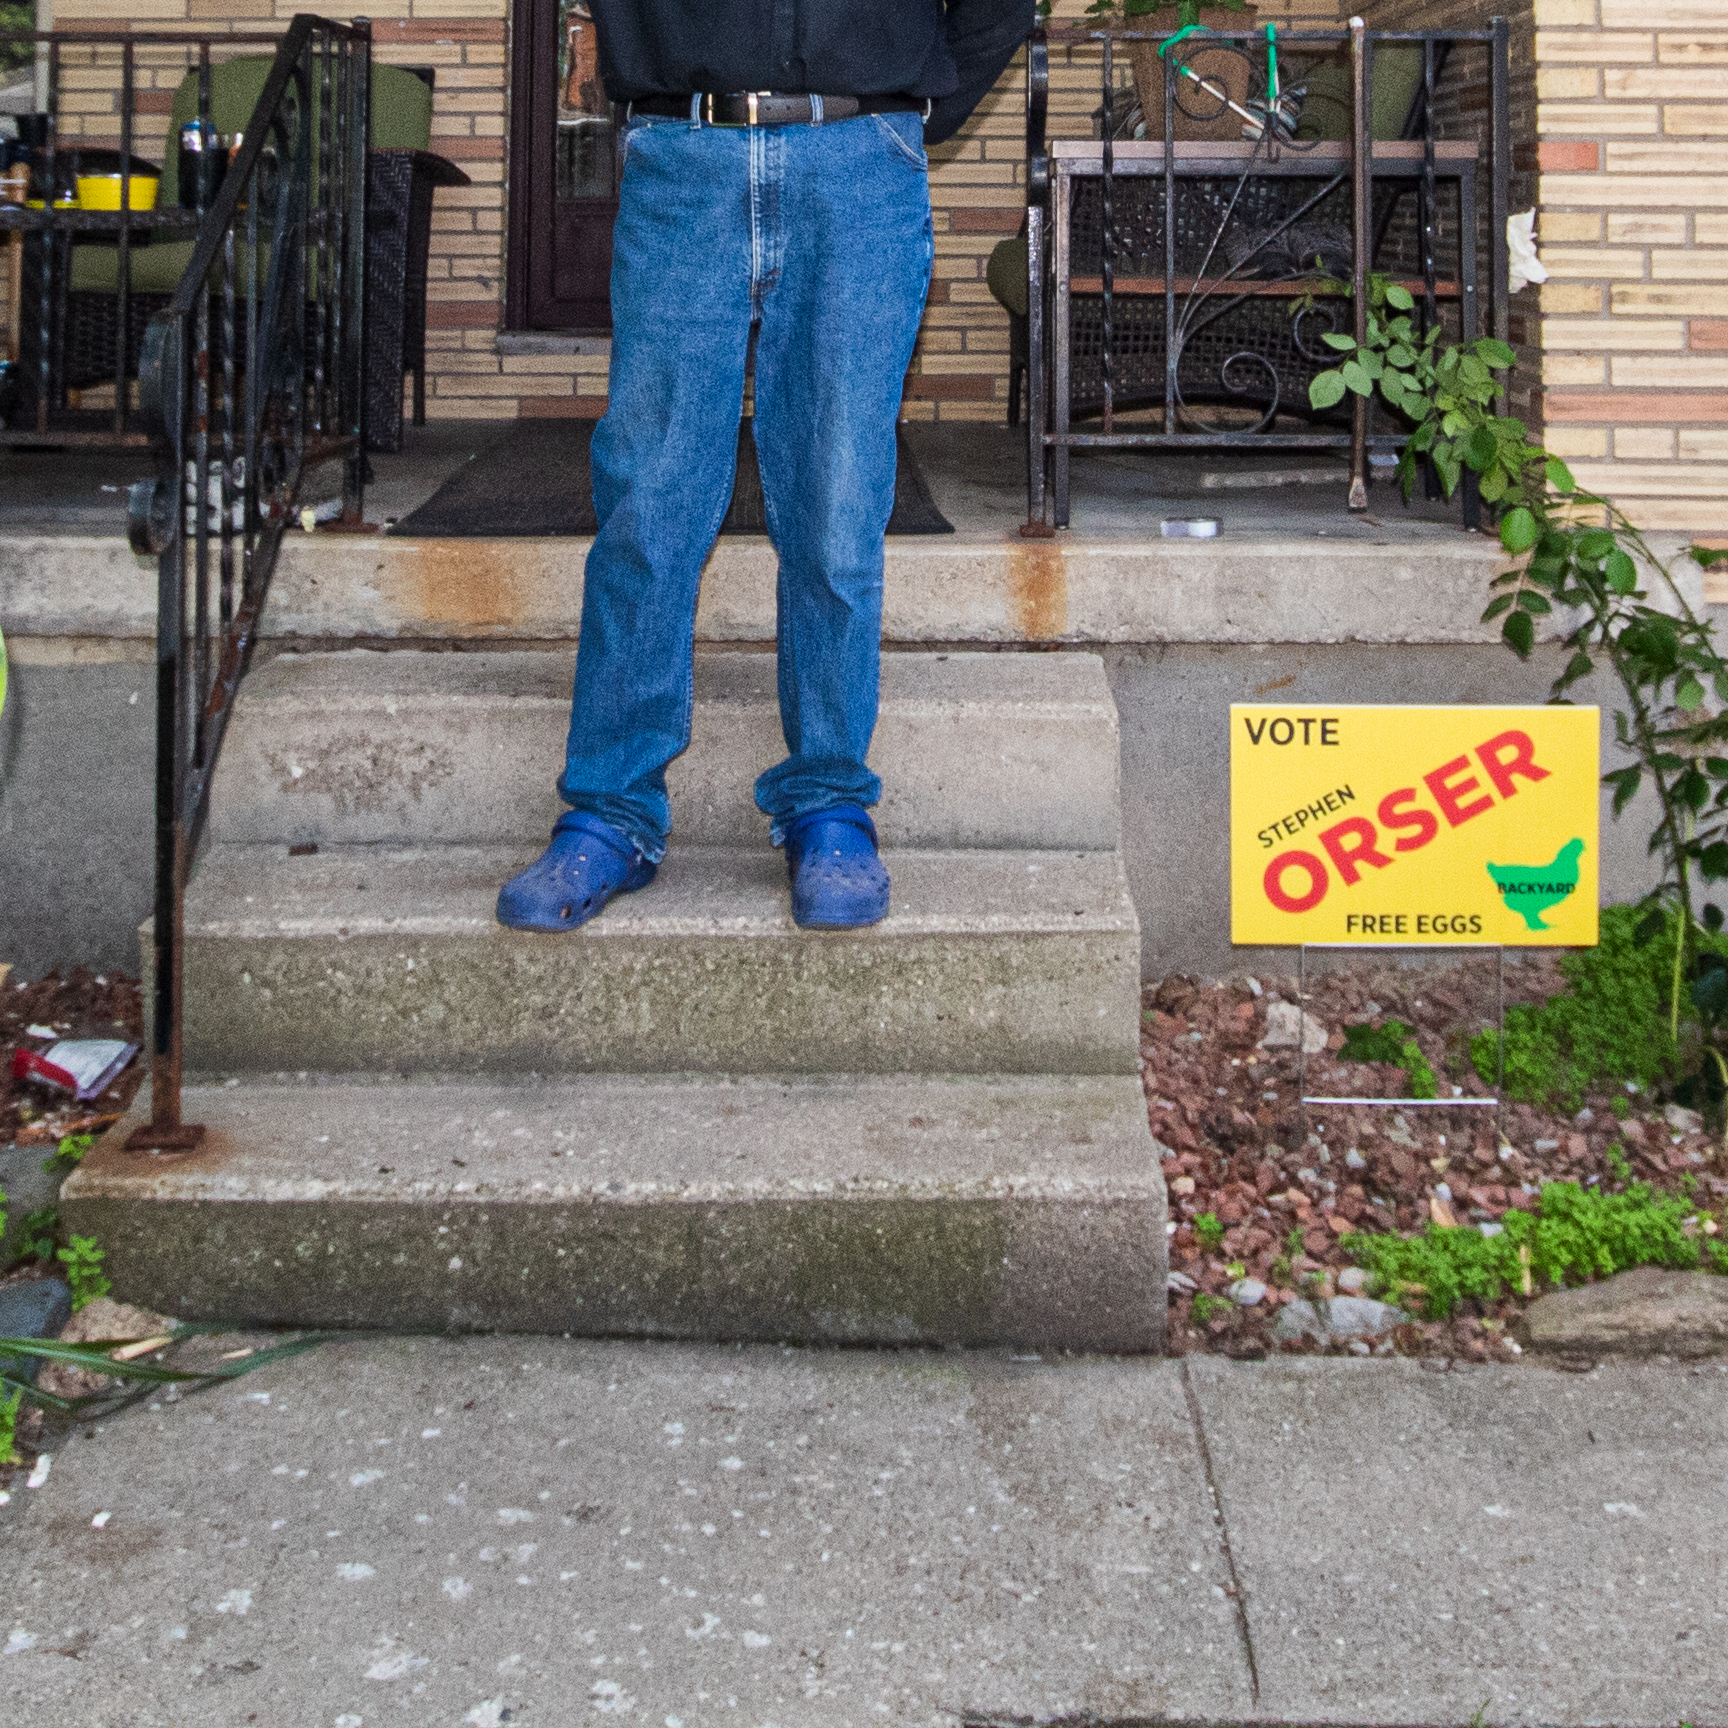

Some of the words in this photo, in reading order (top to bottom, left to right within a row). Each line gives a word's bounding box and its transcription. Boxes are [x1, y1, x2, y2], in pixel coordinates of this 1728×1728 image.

[1244, 718, 1340, 746] VOTE
[1257, 784, 1355, 849] STEPHEN
[1262, 729, 1553, 914] ORSER
[1497, 883, 1576, 895] BACKYARD
[1346, 915, 1408, 934] FREE
[1417, 915, 1482, 934] EGGS
